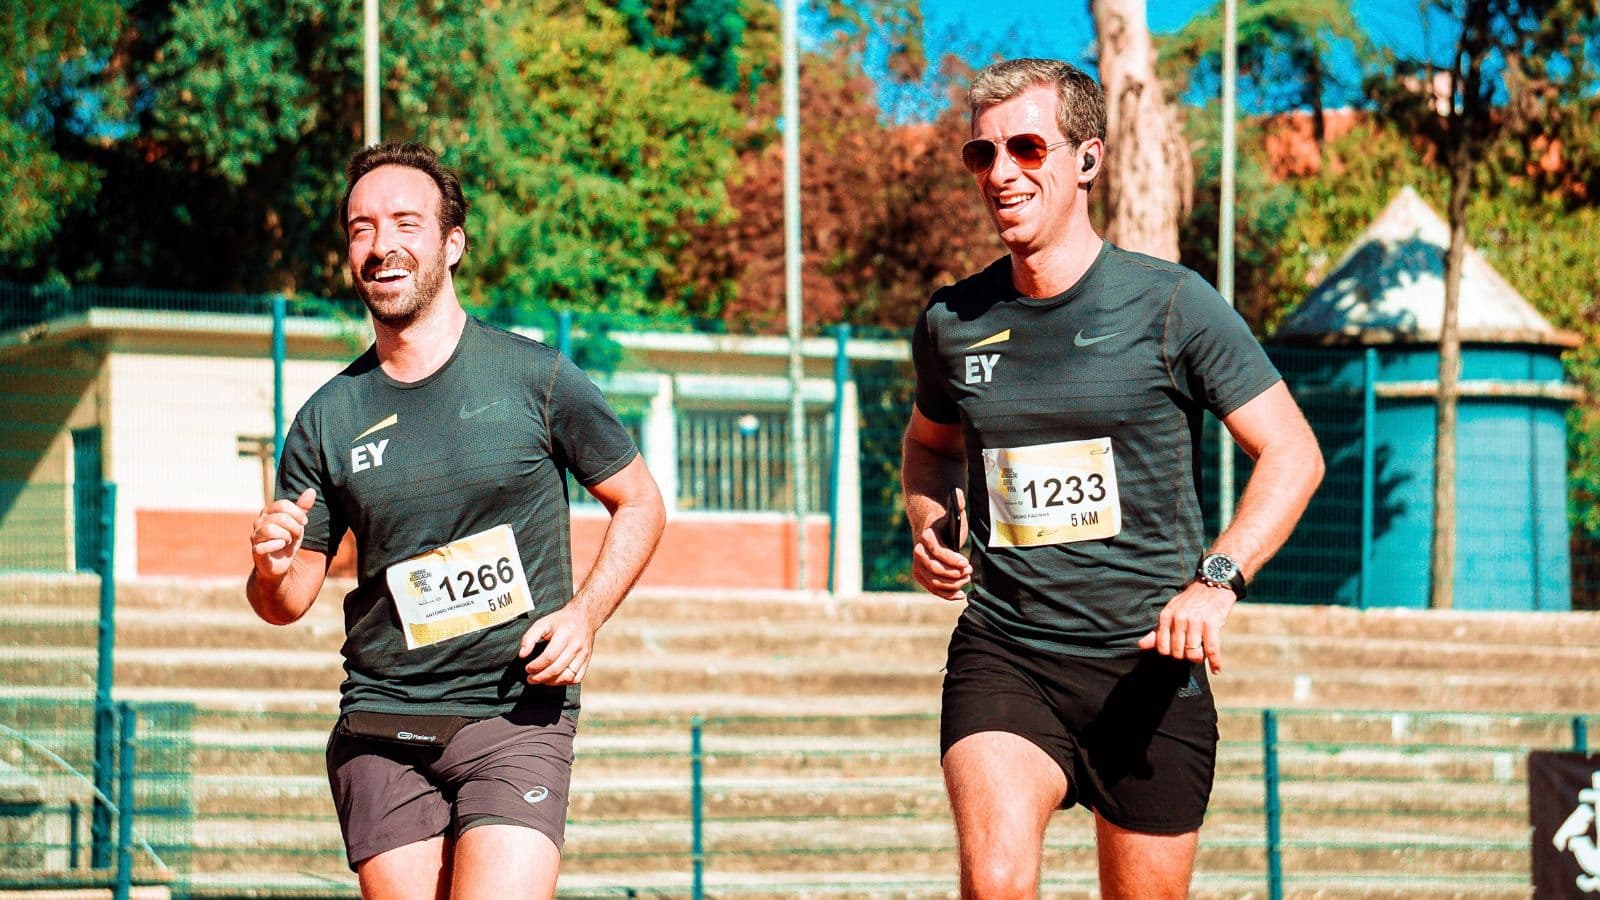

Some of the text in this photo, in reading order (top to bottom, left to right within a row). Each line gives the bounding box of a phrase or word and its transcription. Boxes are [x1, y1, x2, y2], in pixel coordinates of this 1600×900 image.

[965, 353, 1001, 385] EY
[351, 438, 390, 473] EY
[1023, 473, 1106, 509] 1233
[1071, 511, 1099, 527] 5 KM
[439, 557, 514, 601] 1266
[488, 591, 513, 612] 5 KM
